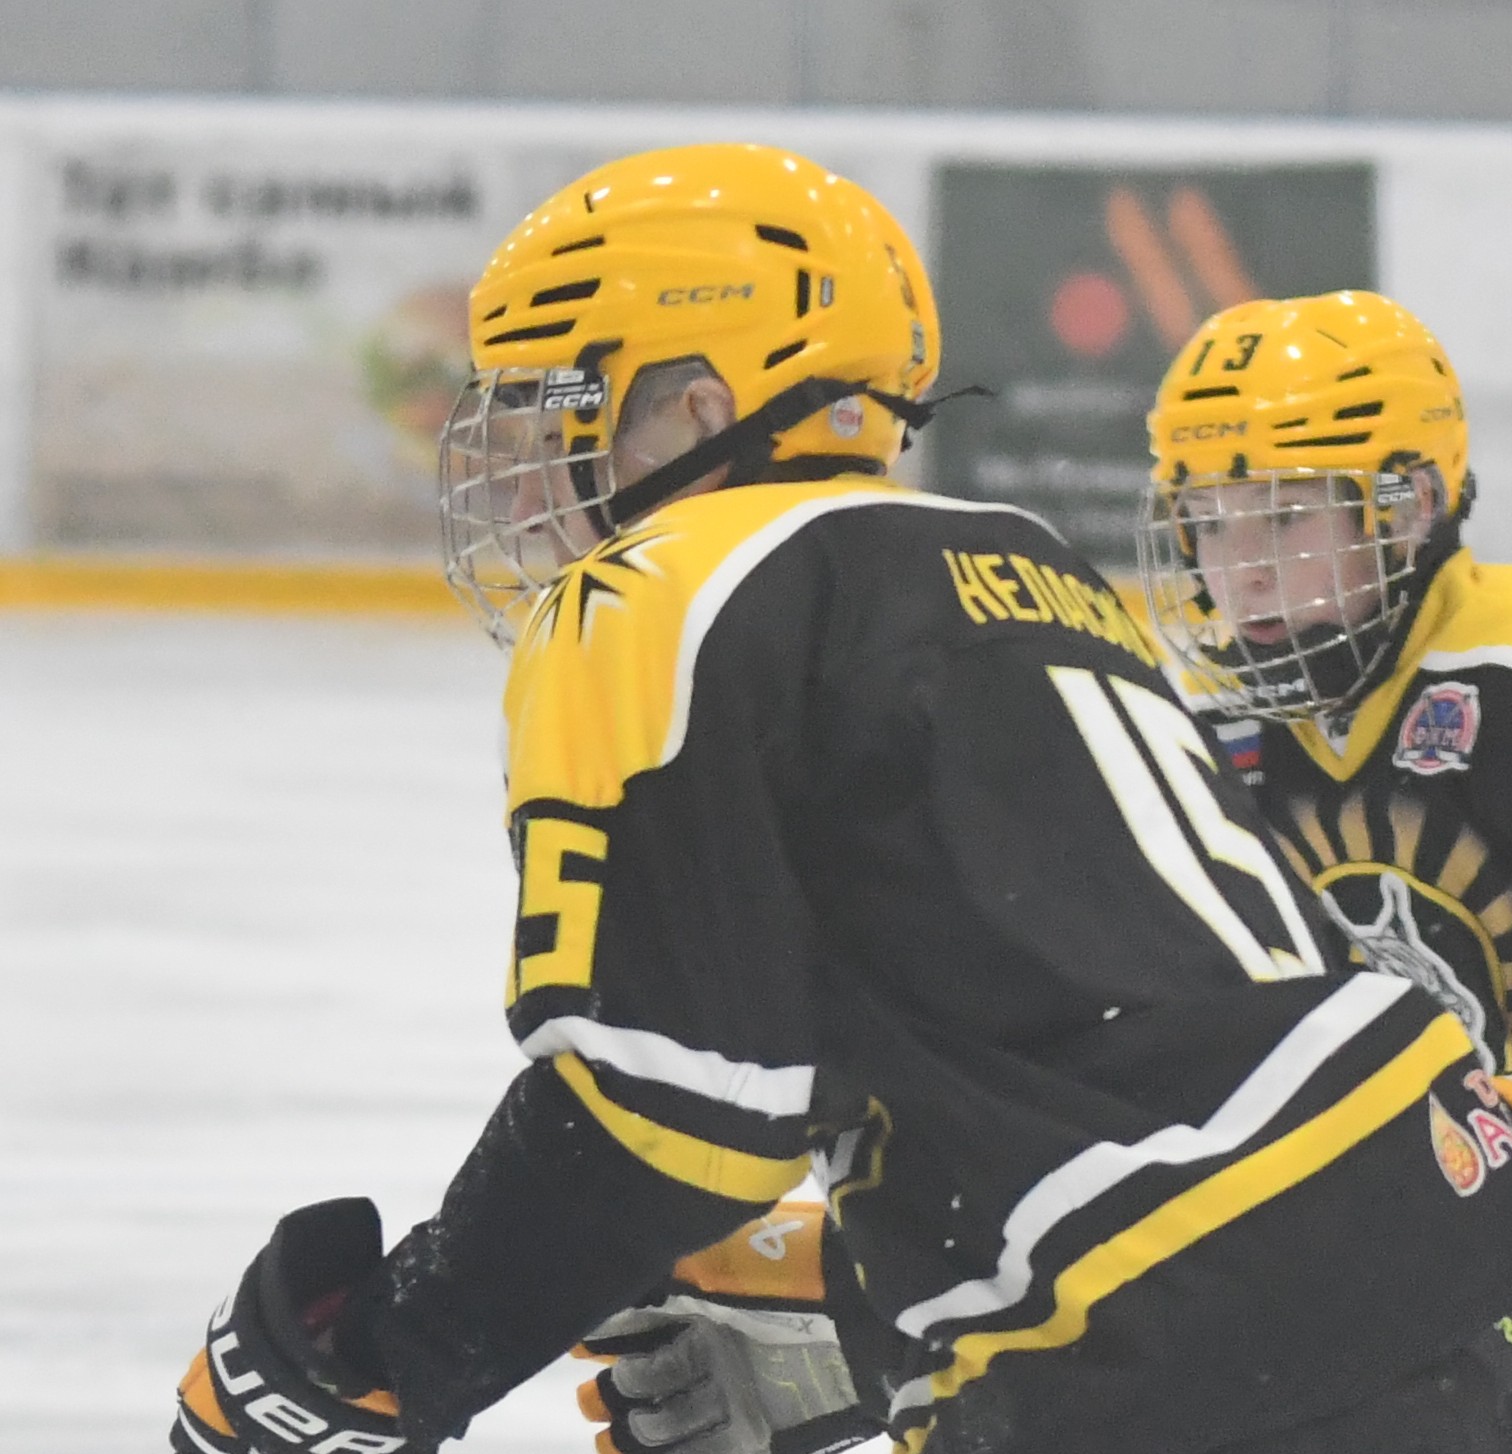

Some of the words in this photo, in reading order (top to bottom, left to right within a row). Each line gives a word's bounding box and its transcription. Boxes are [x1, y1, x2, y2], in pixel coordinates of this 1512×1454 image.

[657, 284, 756, 305] CCM
[1190, 332, 1263, 377] 13
[545, 391, 604, 411] CCM
[1170, 420, 1248, 443] CCM
